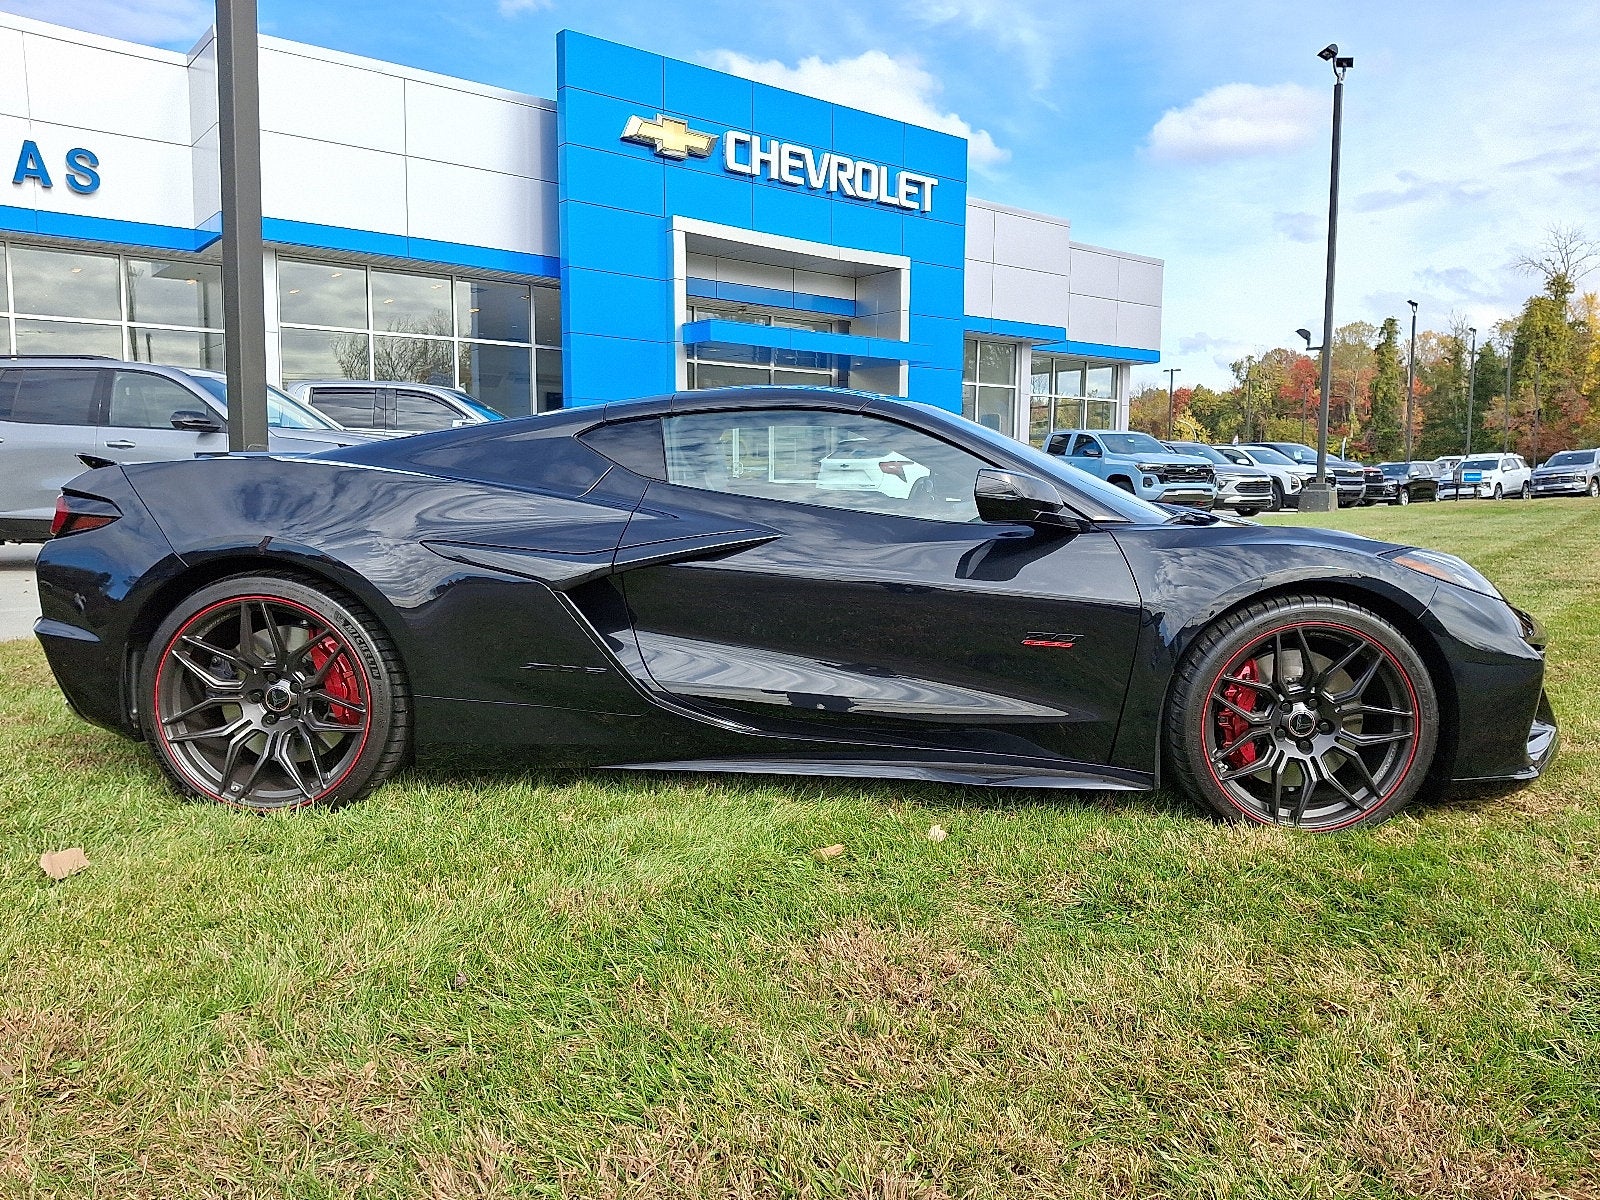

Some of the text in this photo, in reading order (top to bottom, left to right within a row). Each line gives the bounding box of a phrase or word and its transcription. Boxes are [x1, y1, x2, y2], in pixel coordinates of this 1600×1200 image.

[12, 140, 101, 195] AS
[723, 130, 939, 213] CHEVROLET
[345, 623, 381, 679] MICHELIN
